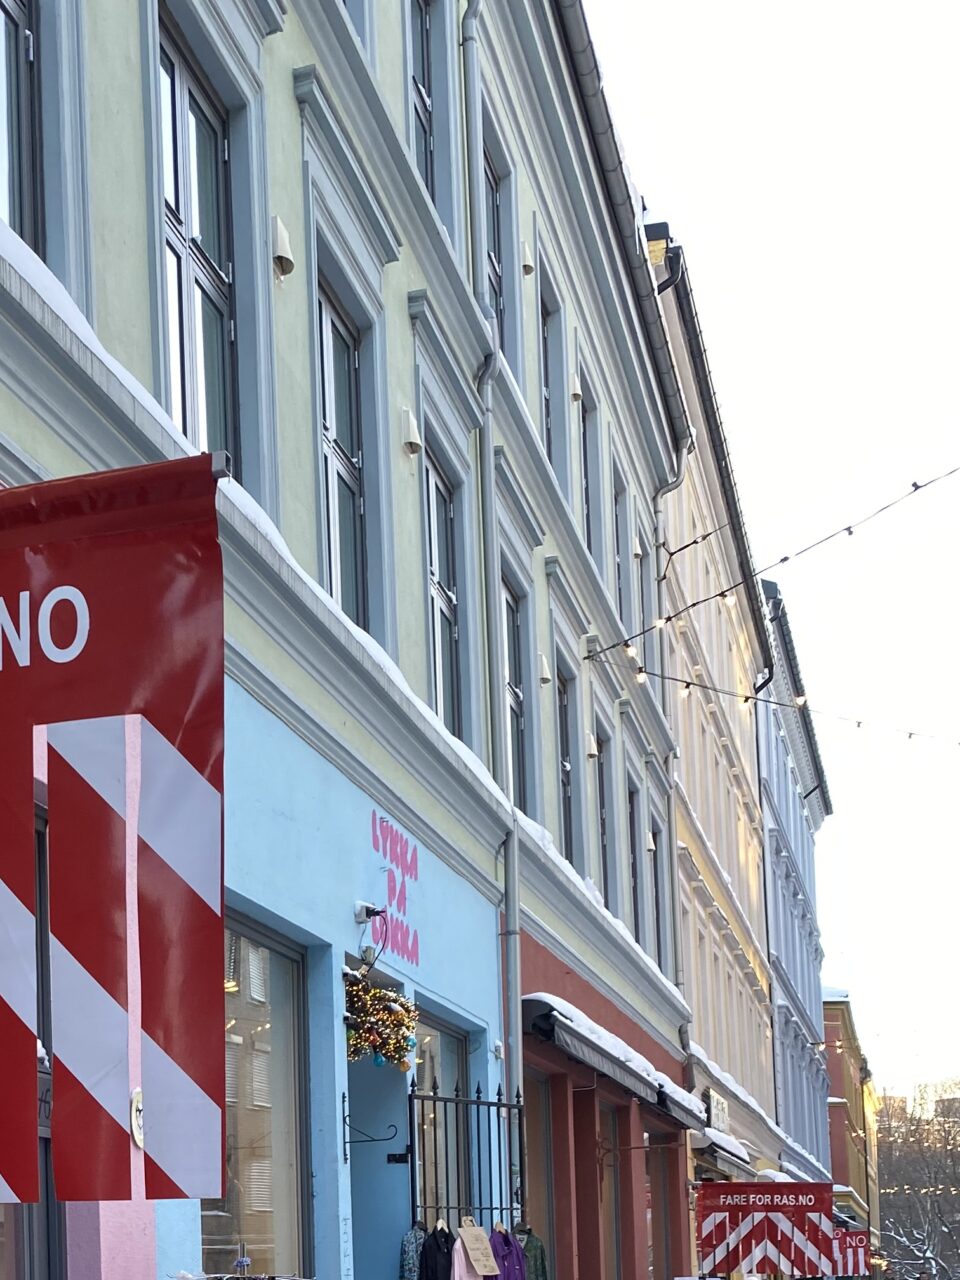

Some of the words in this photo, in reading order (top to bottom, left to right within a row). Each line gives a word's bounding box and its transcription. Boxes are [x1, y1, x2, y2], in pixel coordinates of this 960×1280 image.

[720, 1194, 747, 1206] FARE
[749, 1194, 772, 1206] FOR
[773, 1194, 816, 1206] RAS.NO
